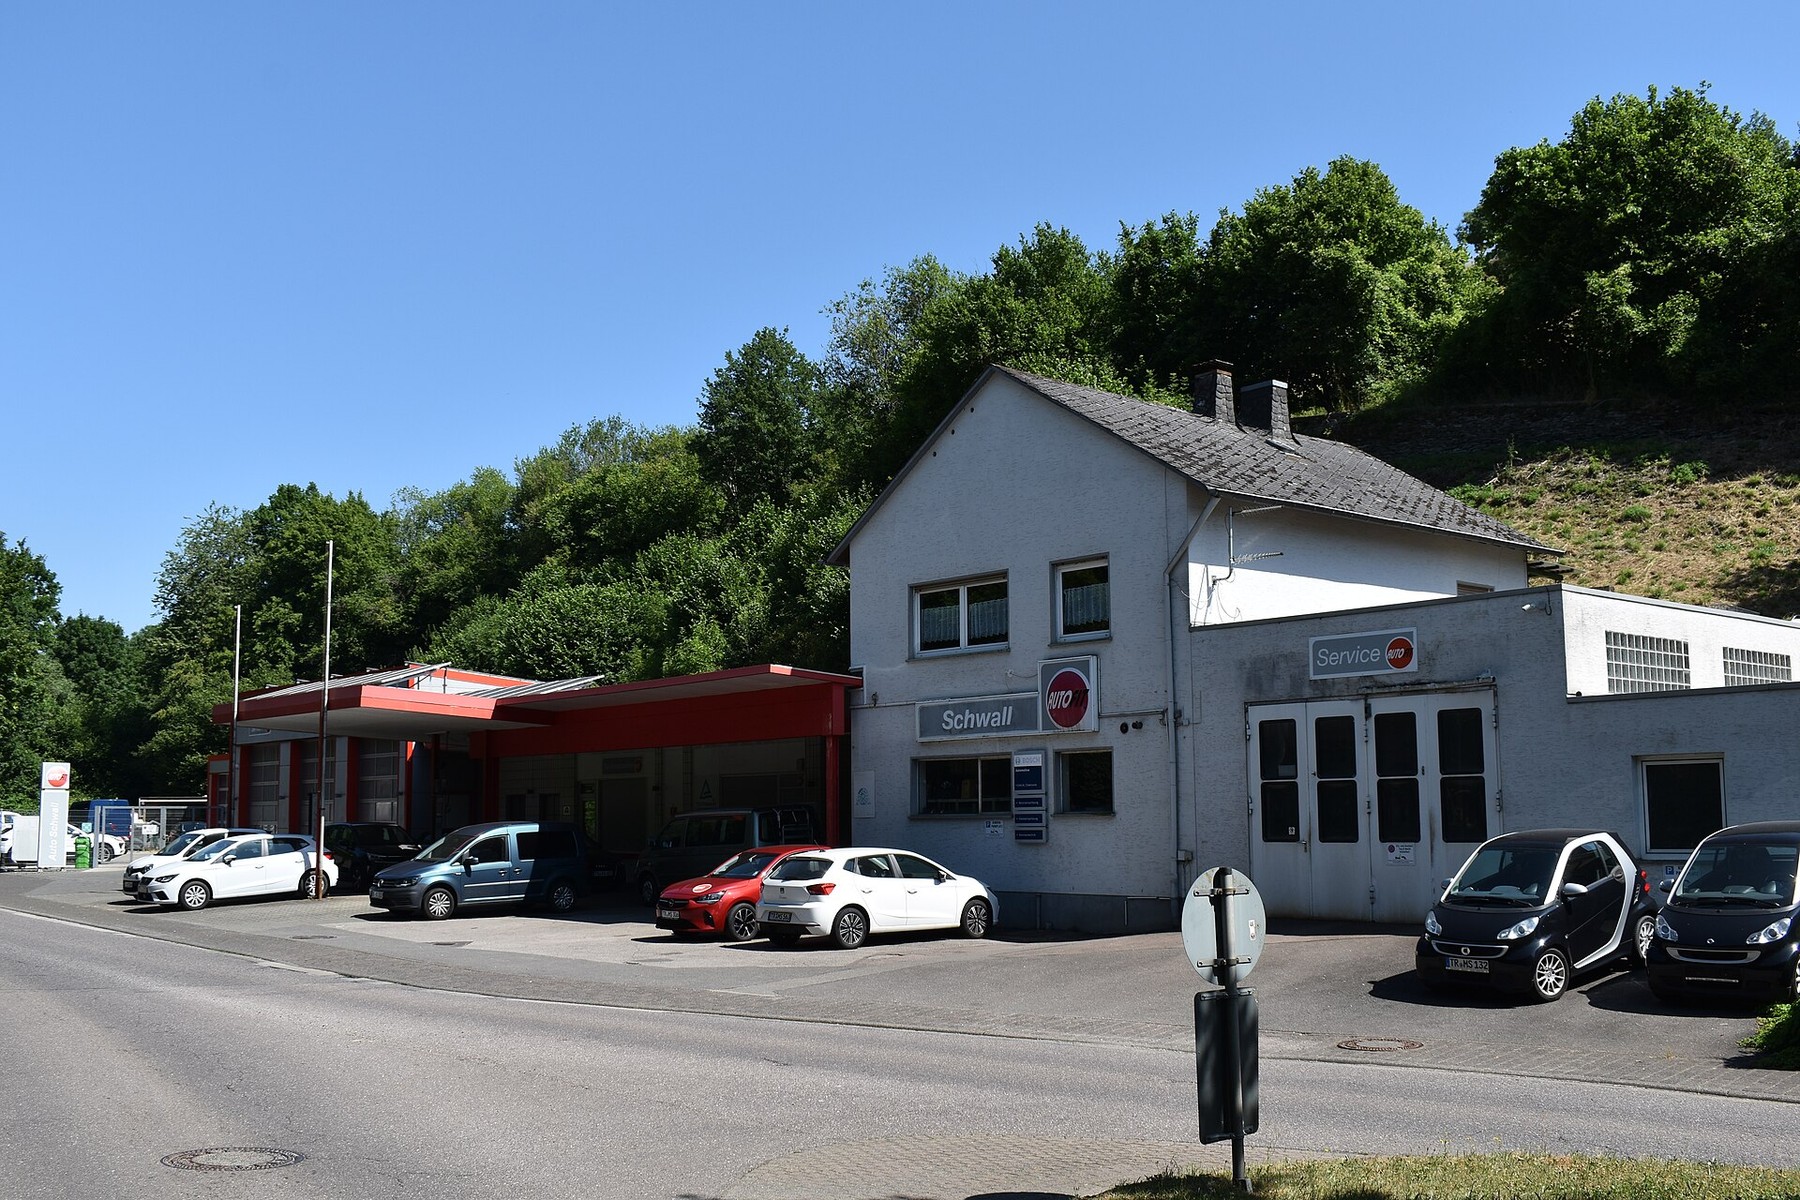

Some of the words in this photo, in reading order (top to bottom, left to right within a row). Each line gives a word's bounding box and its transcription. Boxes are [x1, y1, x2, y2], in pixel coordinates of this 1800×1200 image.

[1316, 645, 1381, 667] Service
[941, 705, 1013, 730] Schwall
[49, 801, 59, 838] Schwall
[48, 839, 58, 862] Auto
